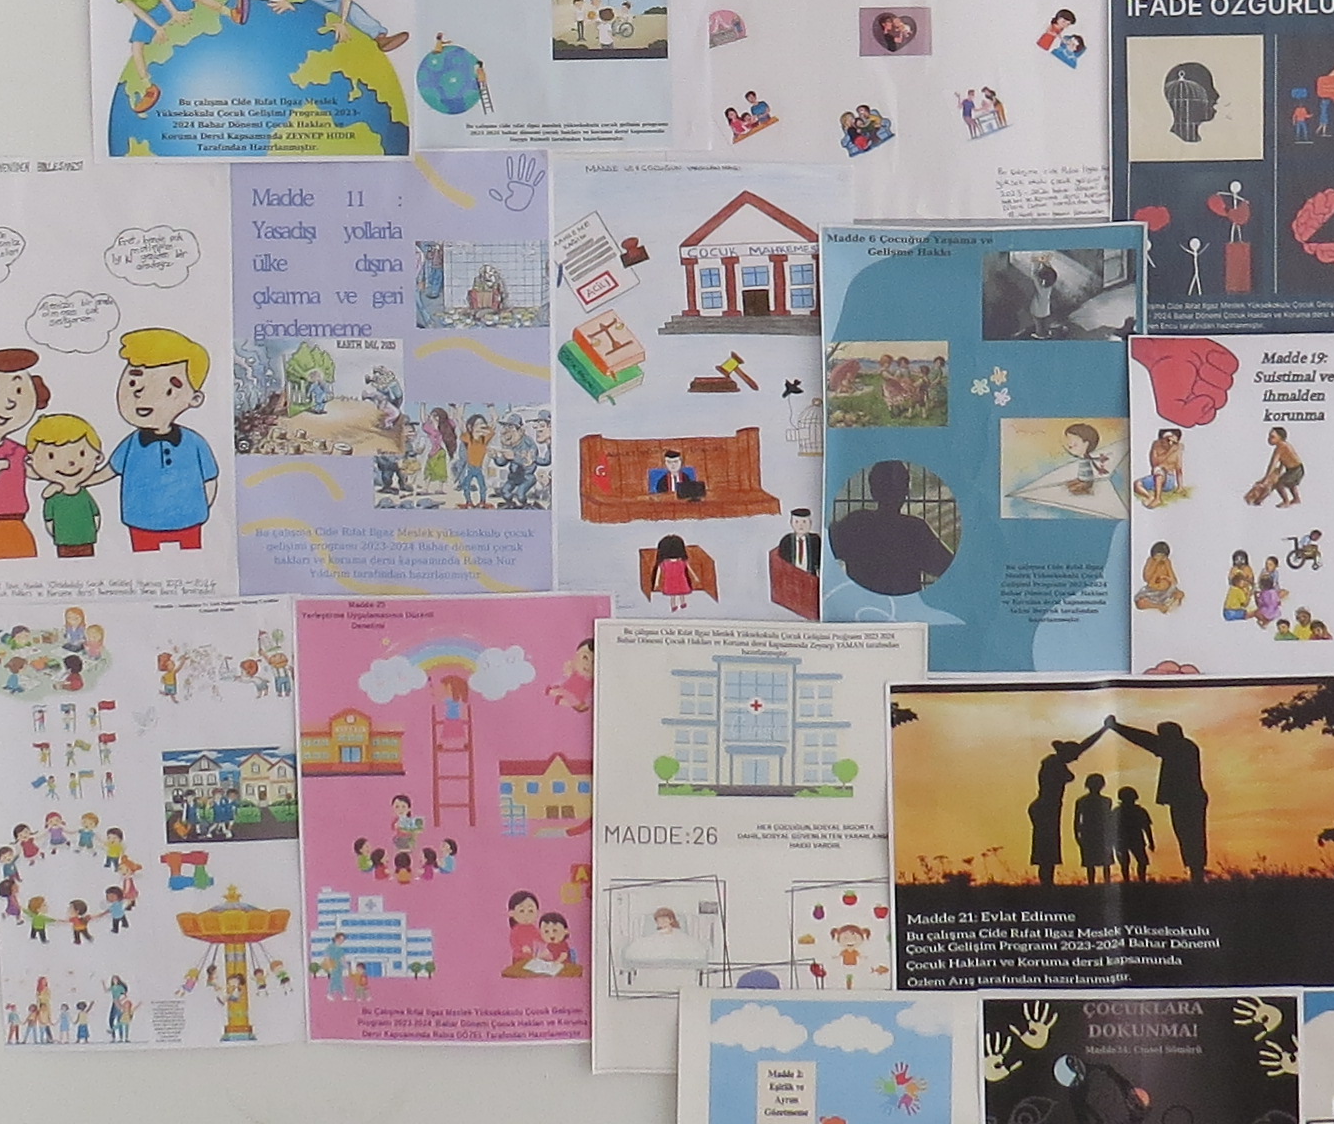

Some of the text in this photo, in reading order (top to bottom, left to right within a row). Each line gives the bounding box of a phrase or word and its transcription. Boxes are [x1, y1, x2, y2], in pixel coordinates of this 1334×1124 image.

[252, 188, 366, 207] Madde 11
[251, 220, 404, 245] Yasadışı yollarla
[252, 253, 404, 278] ülke dışına
[252, 285, 404, 310] çıkarma ve geri
[253, 318, 372, 340] göndermeme
[1260, 350, 1329, 365] Madde 19:
[1253, 369, 1318, 384] Suistimal
[1262, 388, 1326, 403] ihmalden
[1262, 408, 1326, 422] korunma
[604, 825, 718, 845] MADDE:26
[906, 910, 1076, 925] Madde 21: Evlat Edinme
[1082, 1001, 1204, 1019] ÇOCUKLARA
[1088, 1023, 1198, 1039] DOKUNMA!
